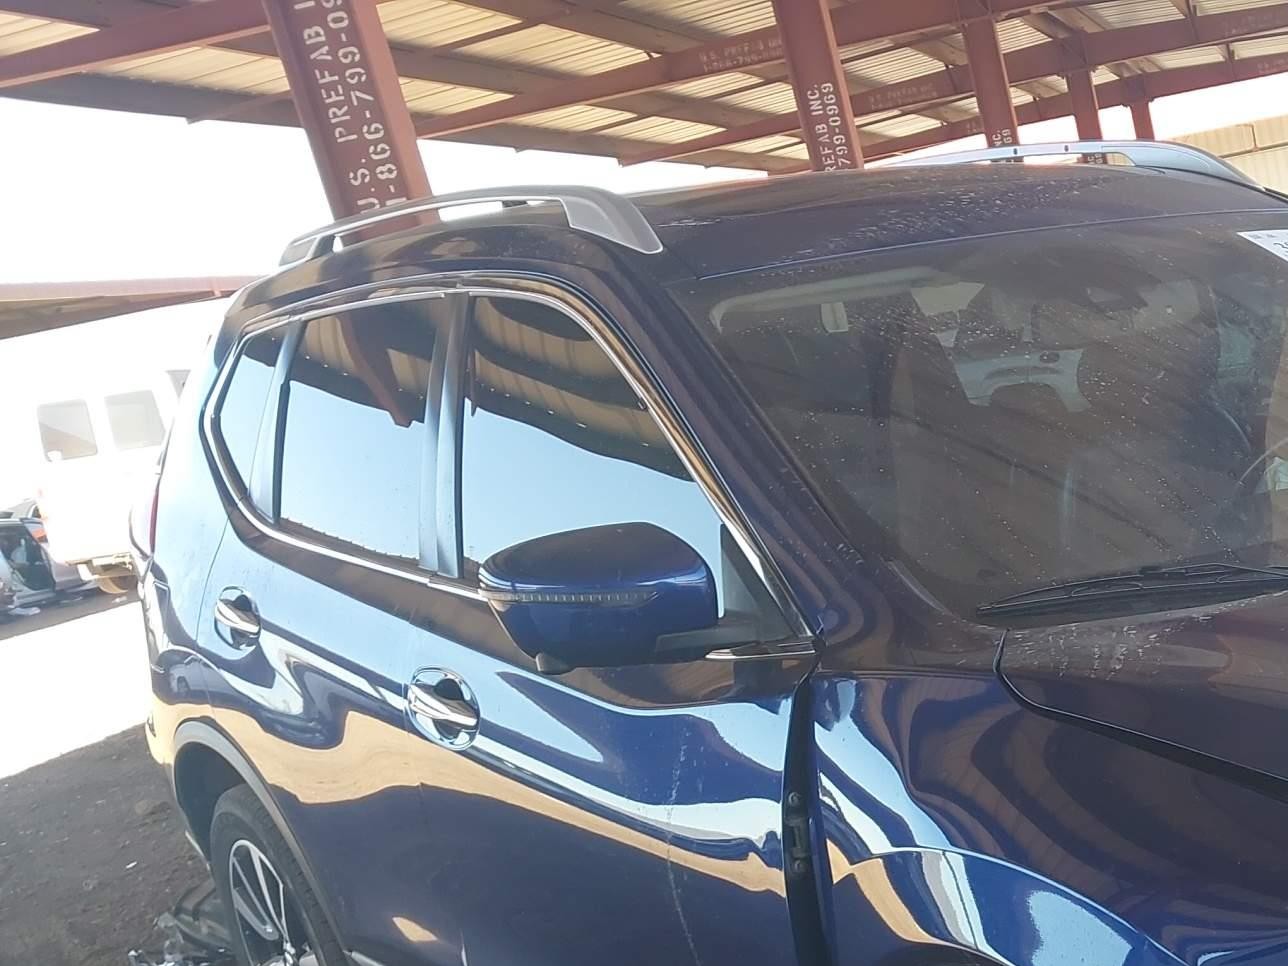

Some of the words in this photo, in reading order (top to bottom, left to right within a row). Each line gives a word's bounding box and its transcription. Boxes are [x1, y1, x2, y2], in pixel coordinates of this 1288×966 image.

[303, 25, 358, 143] PREFAB
[807, 84, 824, 116] INC.
[821, 82, 852, 166] 799-0969
